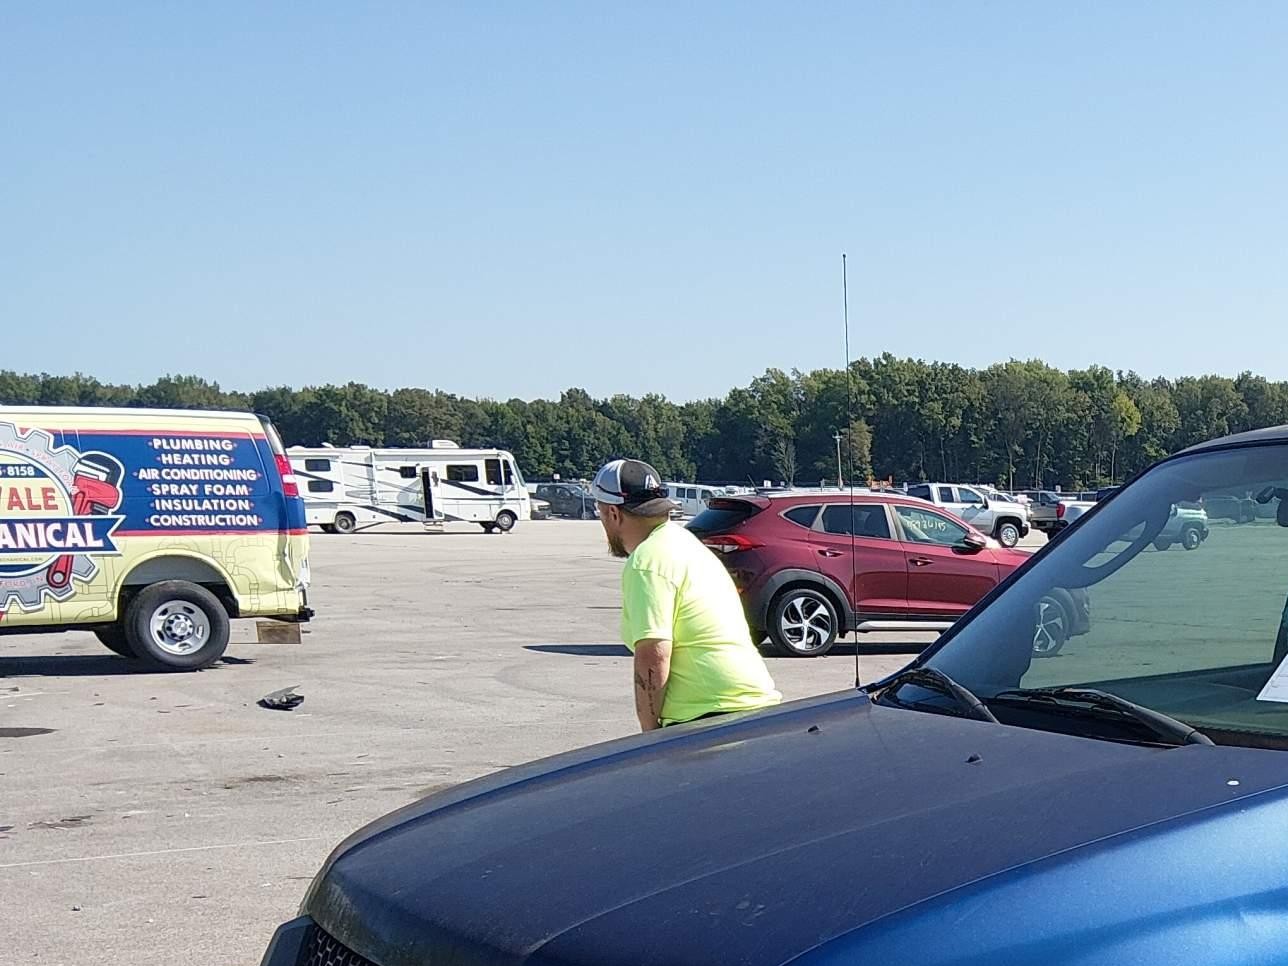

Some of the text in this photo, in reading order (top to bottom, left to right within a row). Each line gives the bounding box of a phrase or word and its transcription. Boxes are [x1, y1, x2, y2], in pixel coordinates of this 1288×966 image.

[152, 438, 233, 451] PLUMBING
[161, 453, 230, 465] HEATING
[138, 468, 257, 480] AIR CONDITIONING
[151, 484, 249, 496] SPRAY FOAM
[0, 487, 59, 511] ALE
[154, 499, 250, 511] INSULATION
[149, 514, 258, 527] CONSTRUCTION
